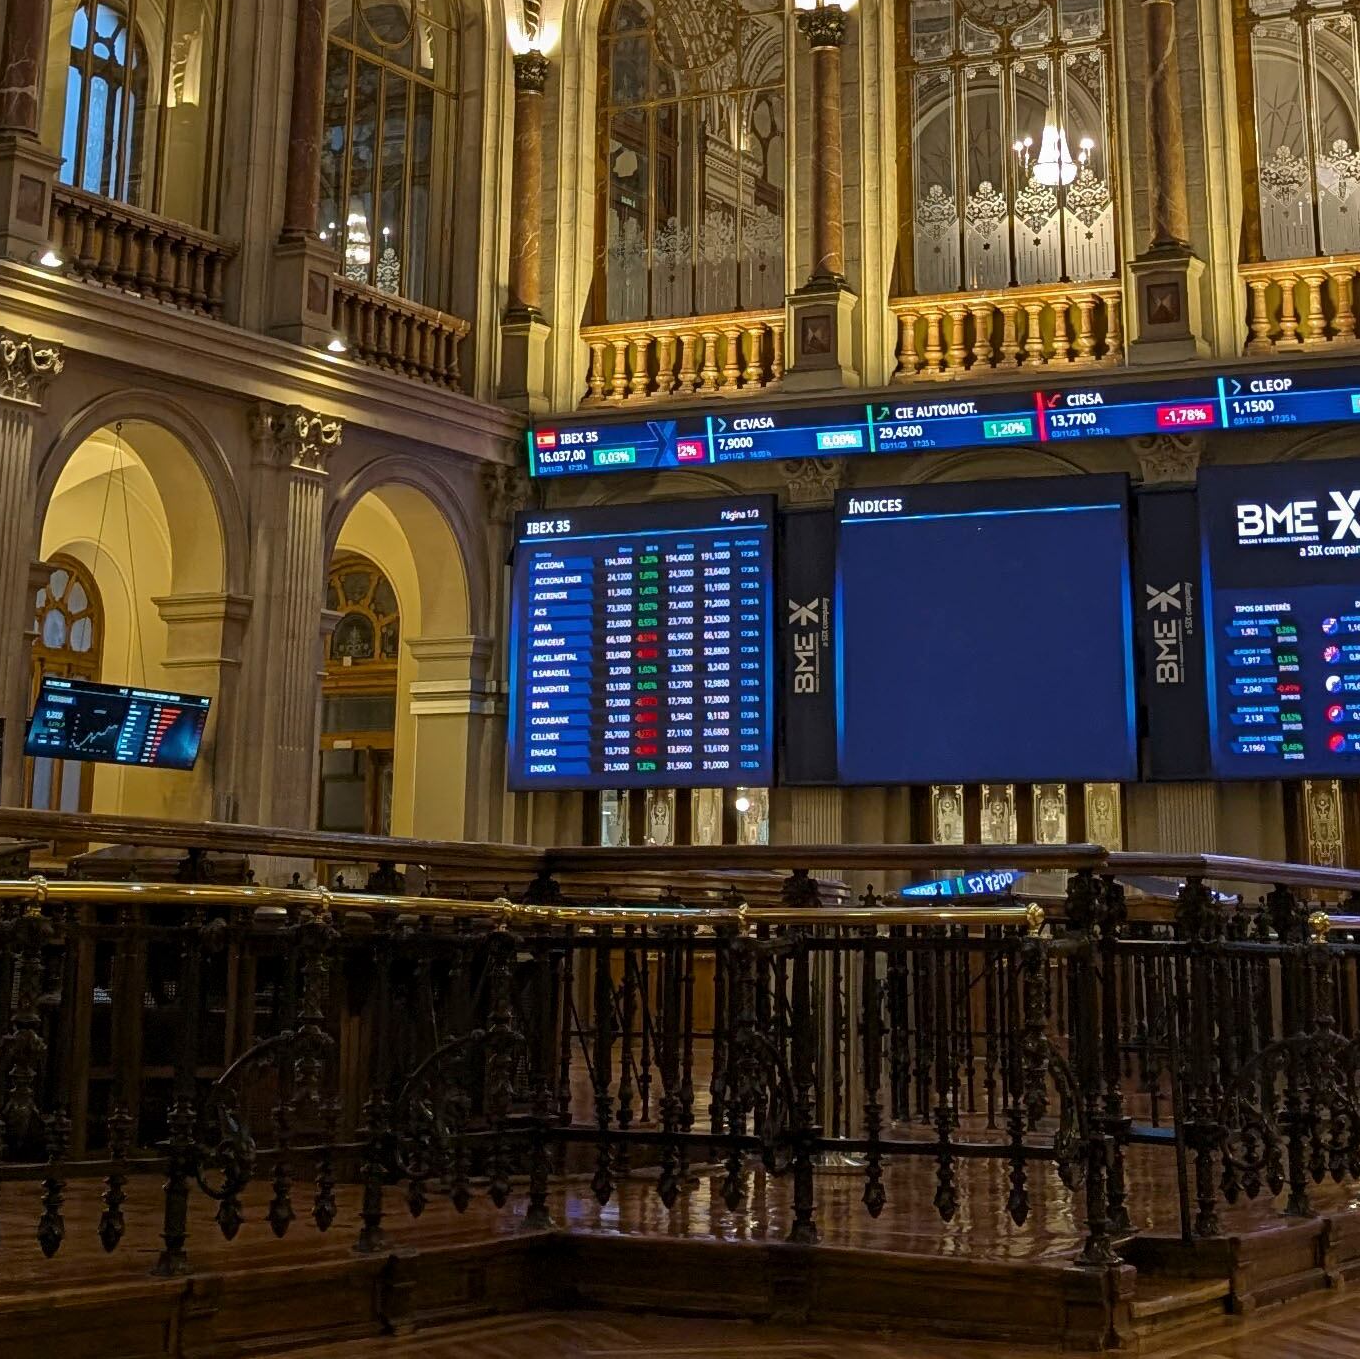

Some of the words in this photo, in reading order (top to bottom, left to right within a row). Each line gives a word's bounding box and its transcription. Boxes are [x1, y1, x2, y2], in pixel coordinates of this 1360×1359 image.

[1250, 378, 1292, 393] CLEOP
[1066, 393, 1103, 407] CIRSA
[1233, 399, 1275, 414] 1,1500
[895, 406, 914, 420] CIE
[916, 402, 978, 418] AUTOMOT.
[1164, 408, 1207, 424] -1,78%
[733, 417, 774, 431] CEVASA
[1050, 412, 1097, 428] 13,7700
[879, 425, 923, 440] 29,4500
[991, 422, 1026, 436] 1,20%
[560, 432, 584, 445] IBEX
[585, 430, 598, 443] 35
[718, 436, 753, 451] 7,9000
[539, 449, 586, 464] 16.037,00
[599, 451, 629, 464] 0,03%
[848, 496, 903, 516] ÍNDICES
[721, 510, 745, 522] Página
[746, 509, 759, 520] 1/3
[1237, 501, 1319, 537] BME
[527, 521, 555, 535] IBEX
[555, 520, 571, 533] 35
[1300, 547, 1306, 557] a
[1307, 545, 1323, 557] SIX
[535, 561, 564, 570] ACCIONA
[534, 608, 547, 616] ACS
[533, 638, 565, 647] AMADEUS
[1154, 619, 1179, 683] BME
[794, 633, 814, 693] BME
[530, 764, 556, 773] ENDESA
